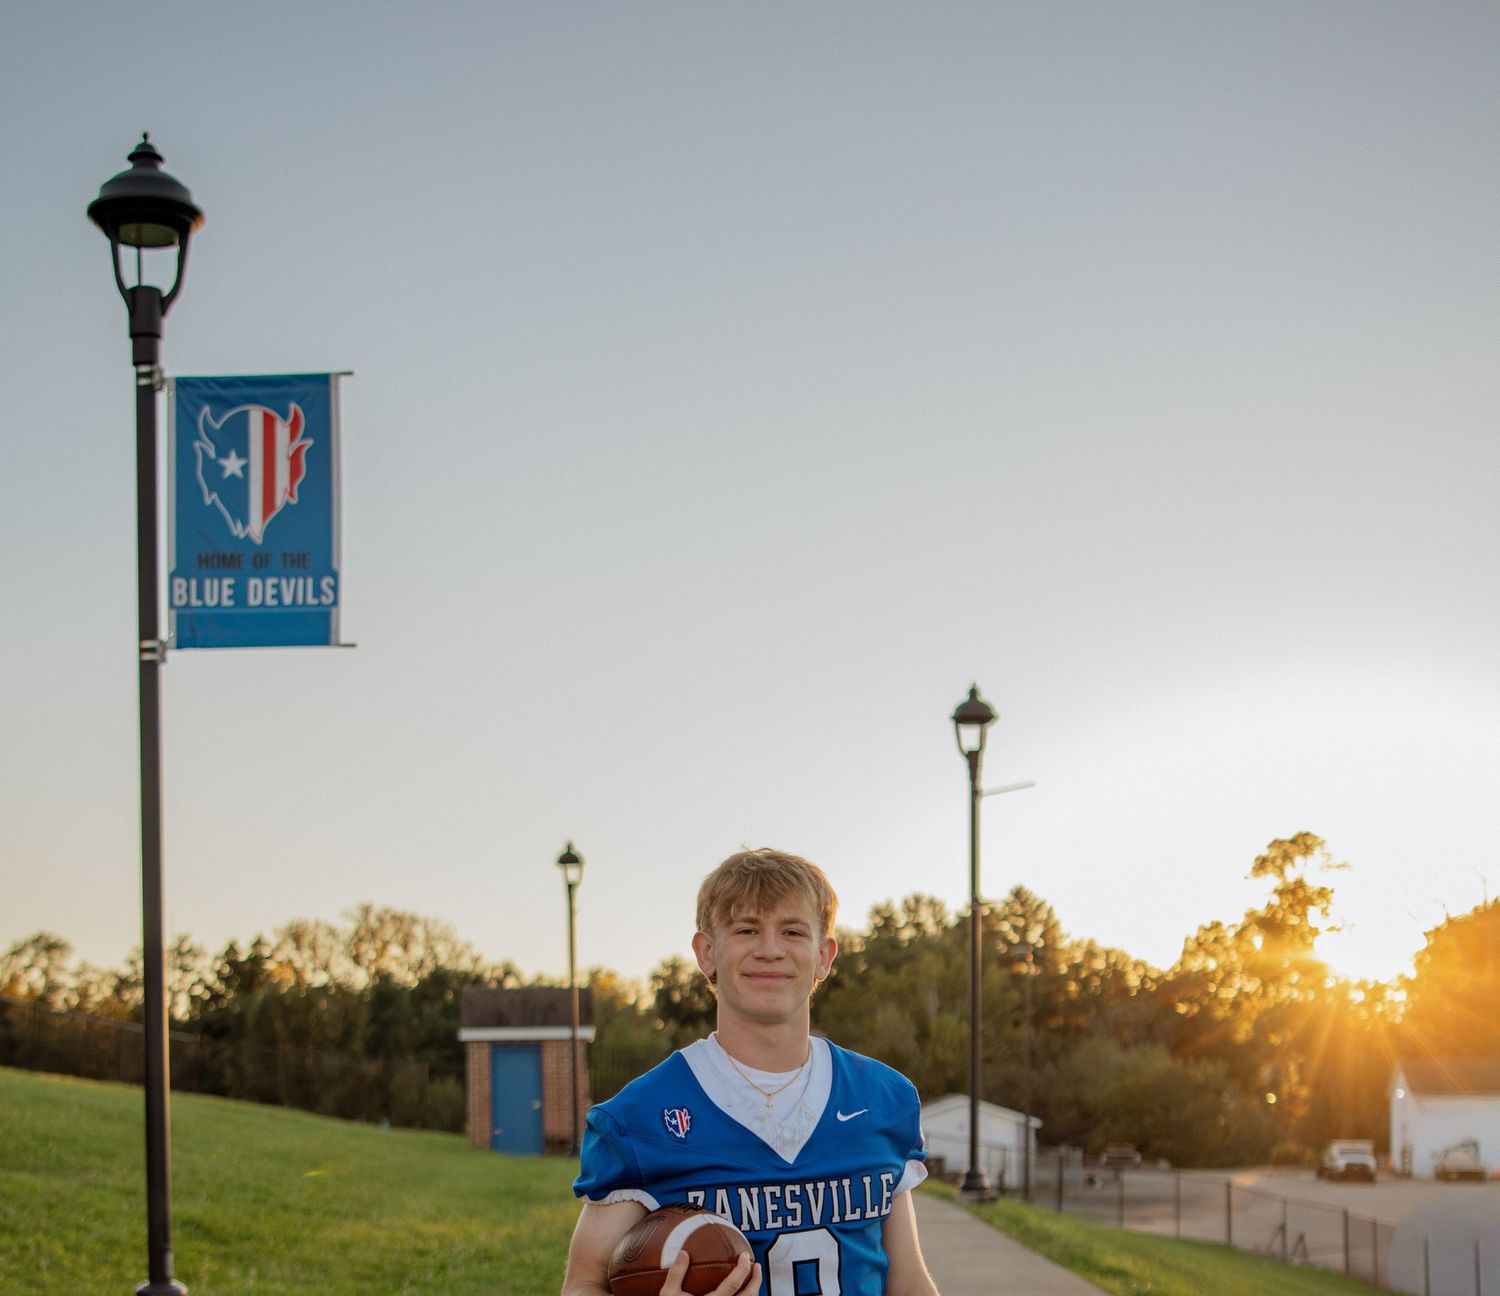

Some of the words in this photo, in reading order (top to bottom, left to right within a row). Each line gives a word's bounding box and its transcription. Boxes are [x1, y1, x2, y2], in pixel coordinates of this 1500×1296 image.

[197, 552, 244, 569] HOME
[252, 552, 272, 569] OF
[281, 552, 309, 569] THE
[172, 576, 235, 607] BLUE
[247, 575, 336, 606] DEVILS
